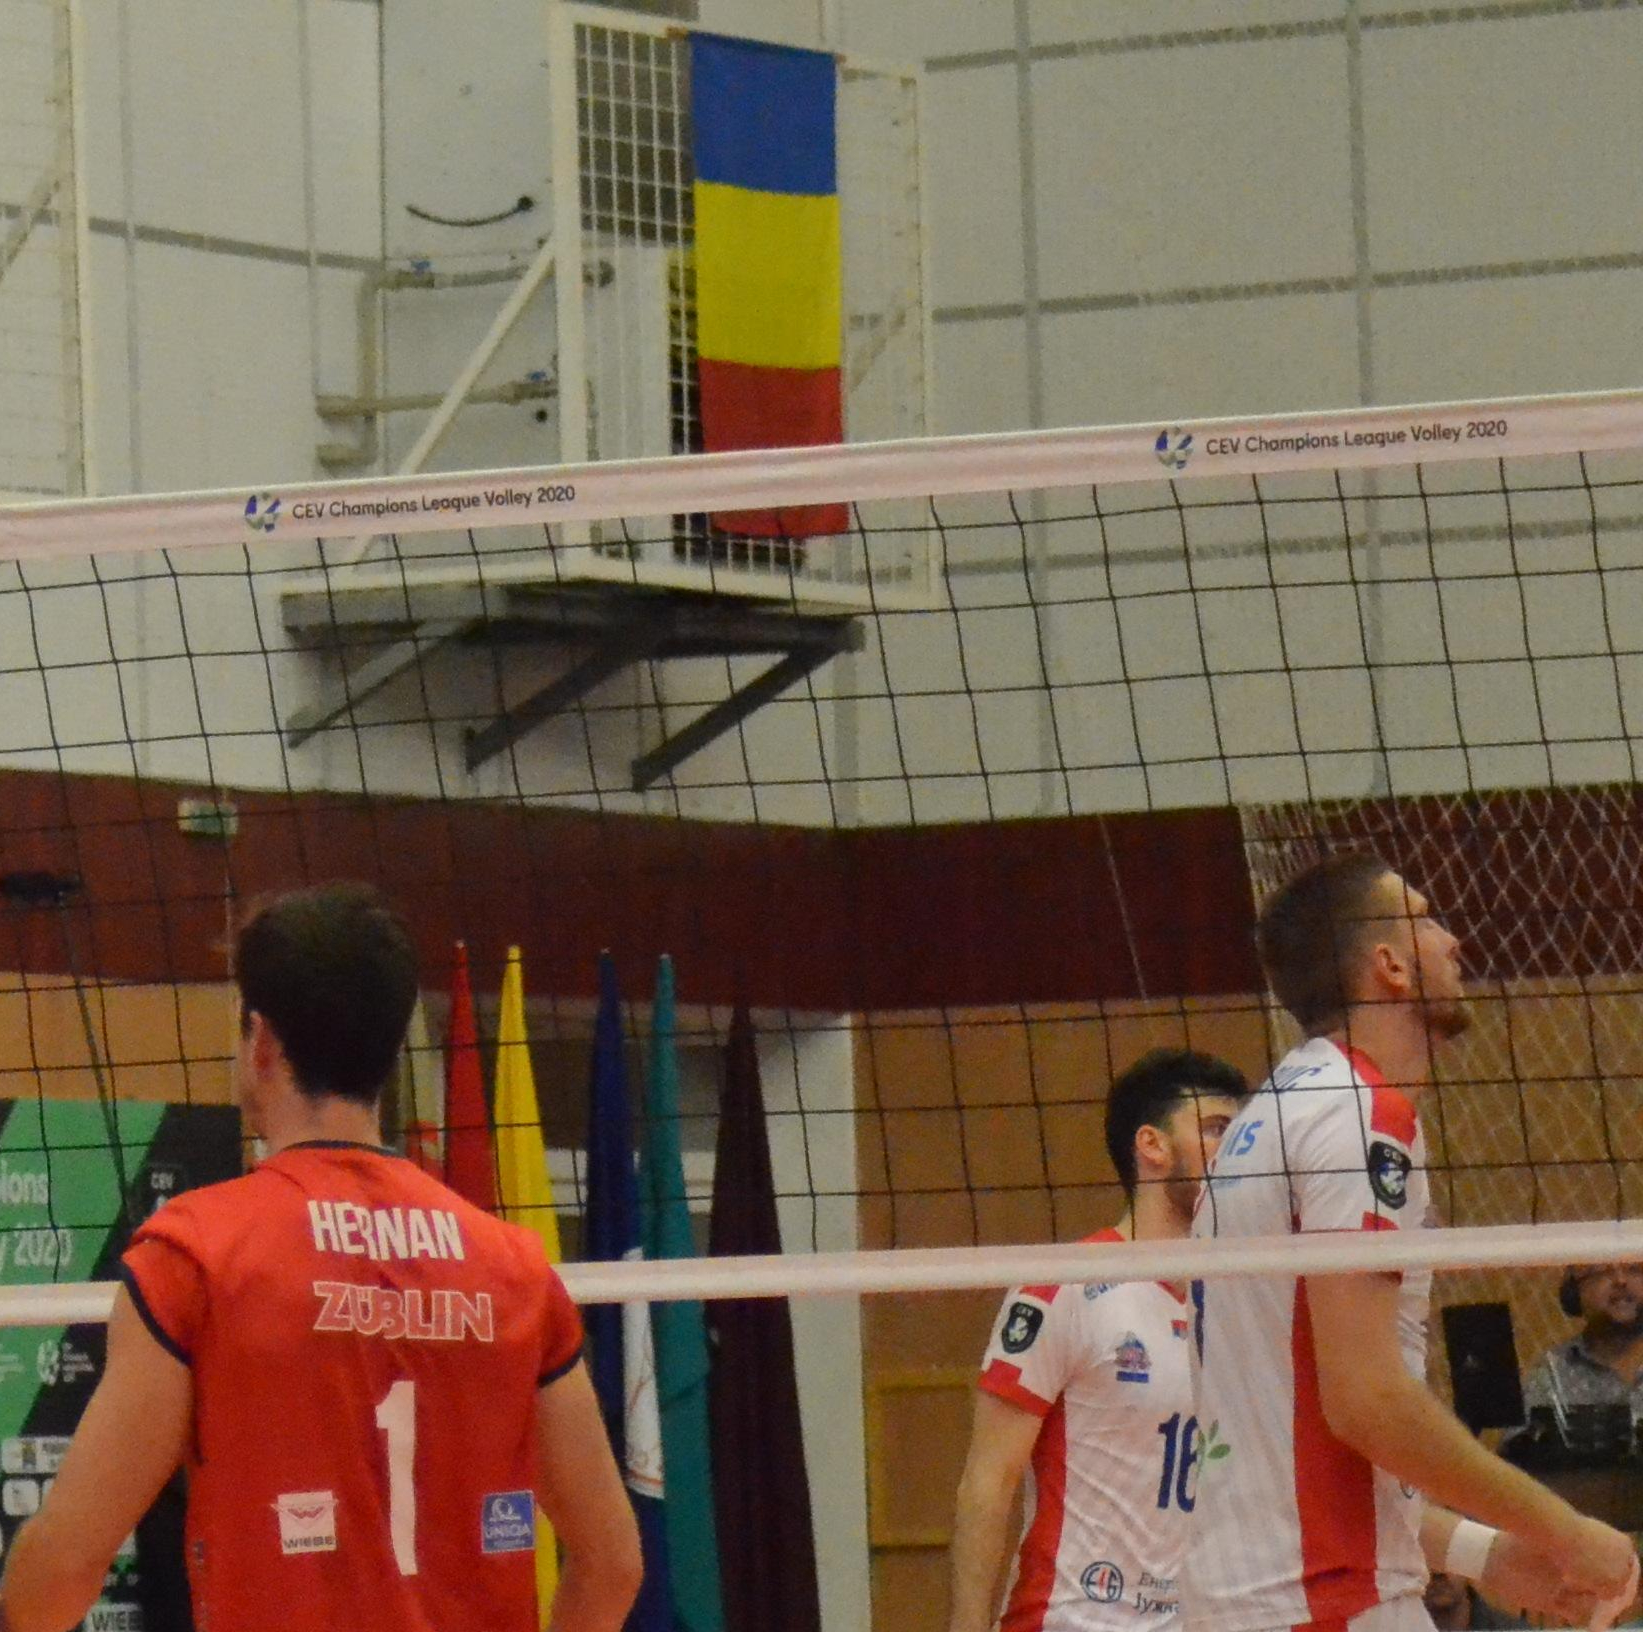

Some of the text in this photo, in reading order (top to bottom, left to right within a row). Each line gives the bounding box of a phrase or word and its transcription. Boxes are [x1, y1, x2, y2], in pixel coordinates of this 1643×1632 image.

[1206, 420, 1508, 456] CEV Champions League Volley 2020
[292, 486, 576, 519] CEV Champions League Volley 2020
[13, 1222, 73, 1268] 2020
[307, 1200, 465, 1262] HERNAN
[374, 1380, 418, 1576] 1
